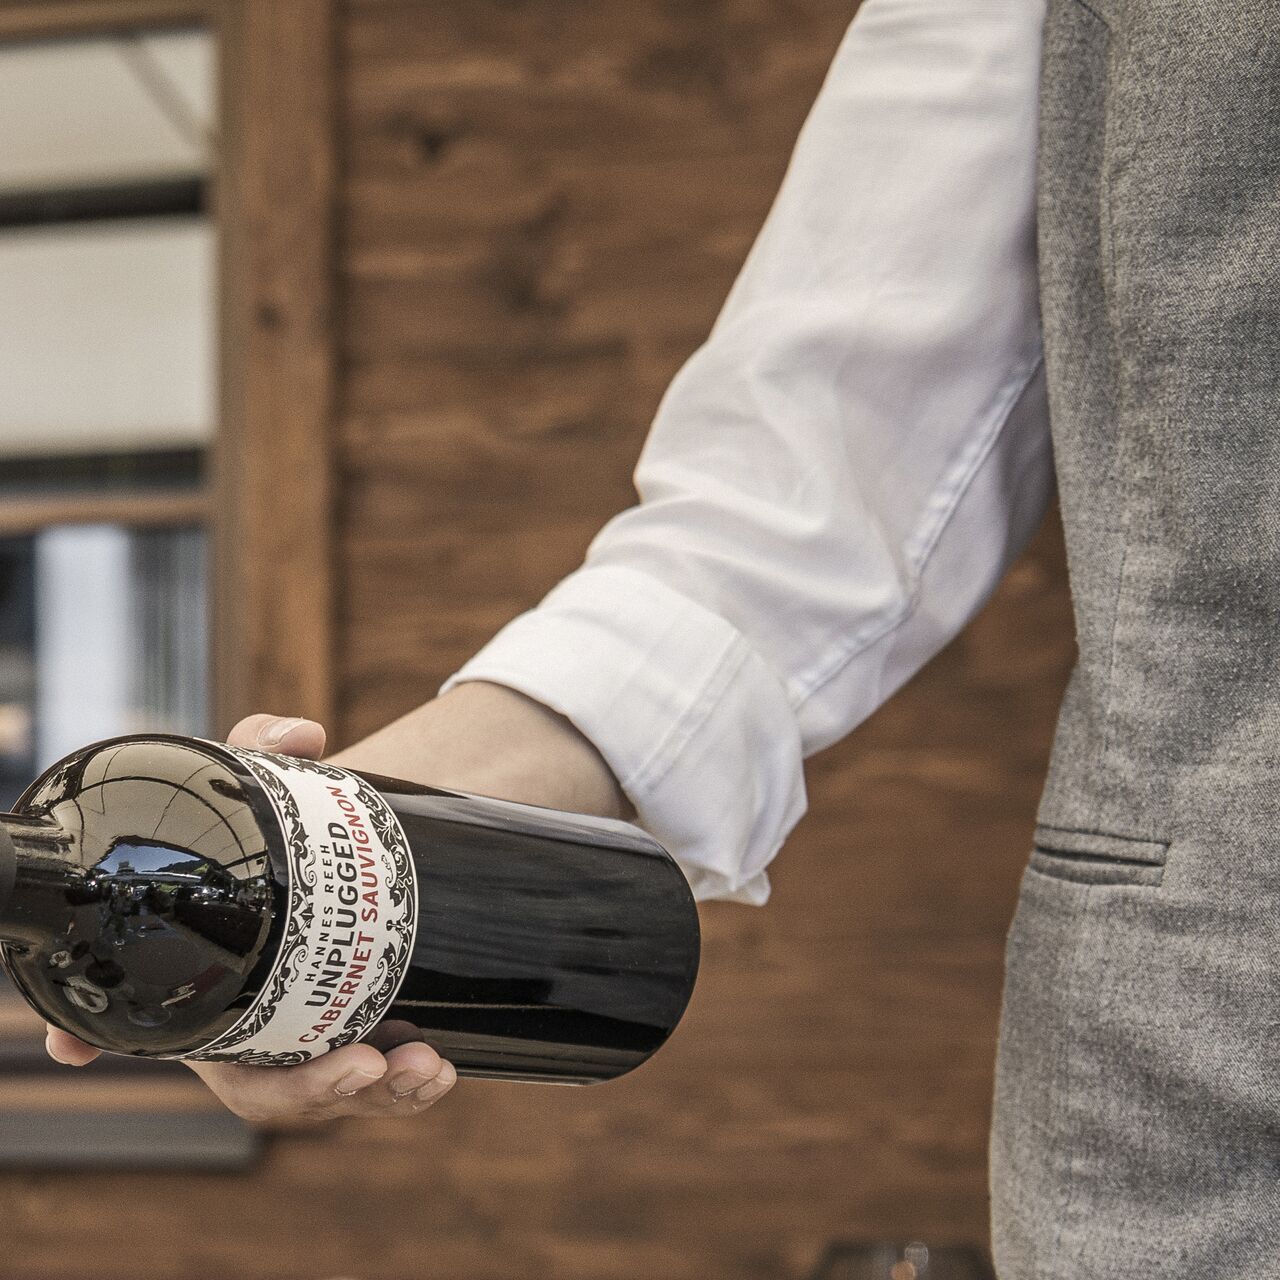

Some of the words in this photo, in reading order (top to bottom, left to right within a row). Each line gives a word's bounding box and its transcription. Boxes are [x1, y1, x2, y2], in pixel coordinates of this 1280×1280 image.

[304, 821, 358, 1007] UNPLUGGED
[305, 906, 333, 982] HANNES
[320, 845, 334, 893] REEH
[326, 786, 379, 924] SAUVIGNON
[298, 931, 375, 1043] CABERNET
